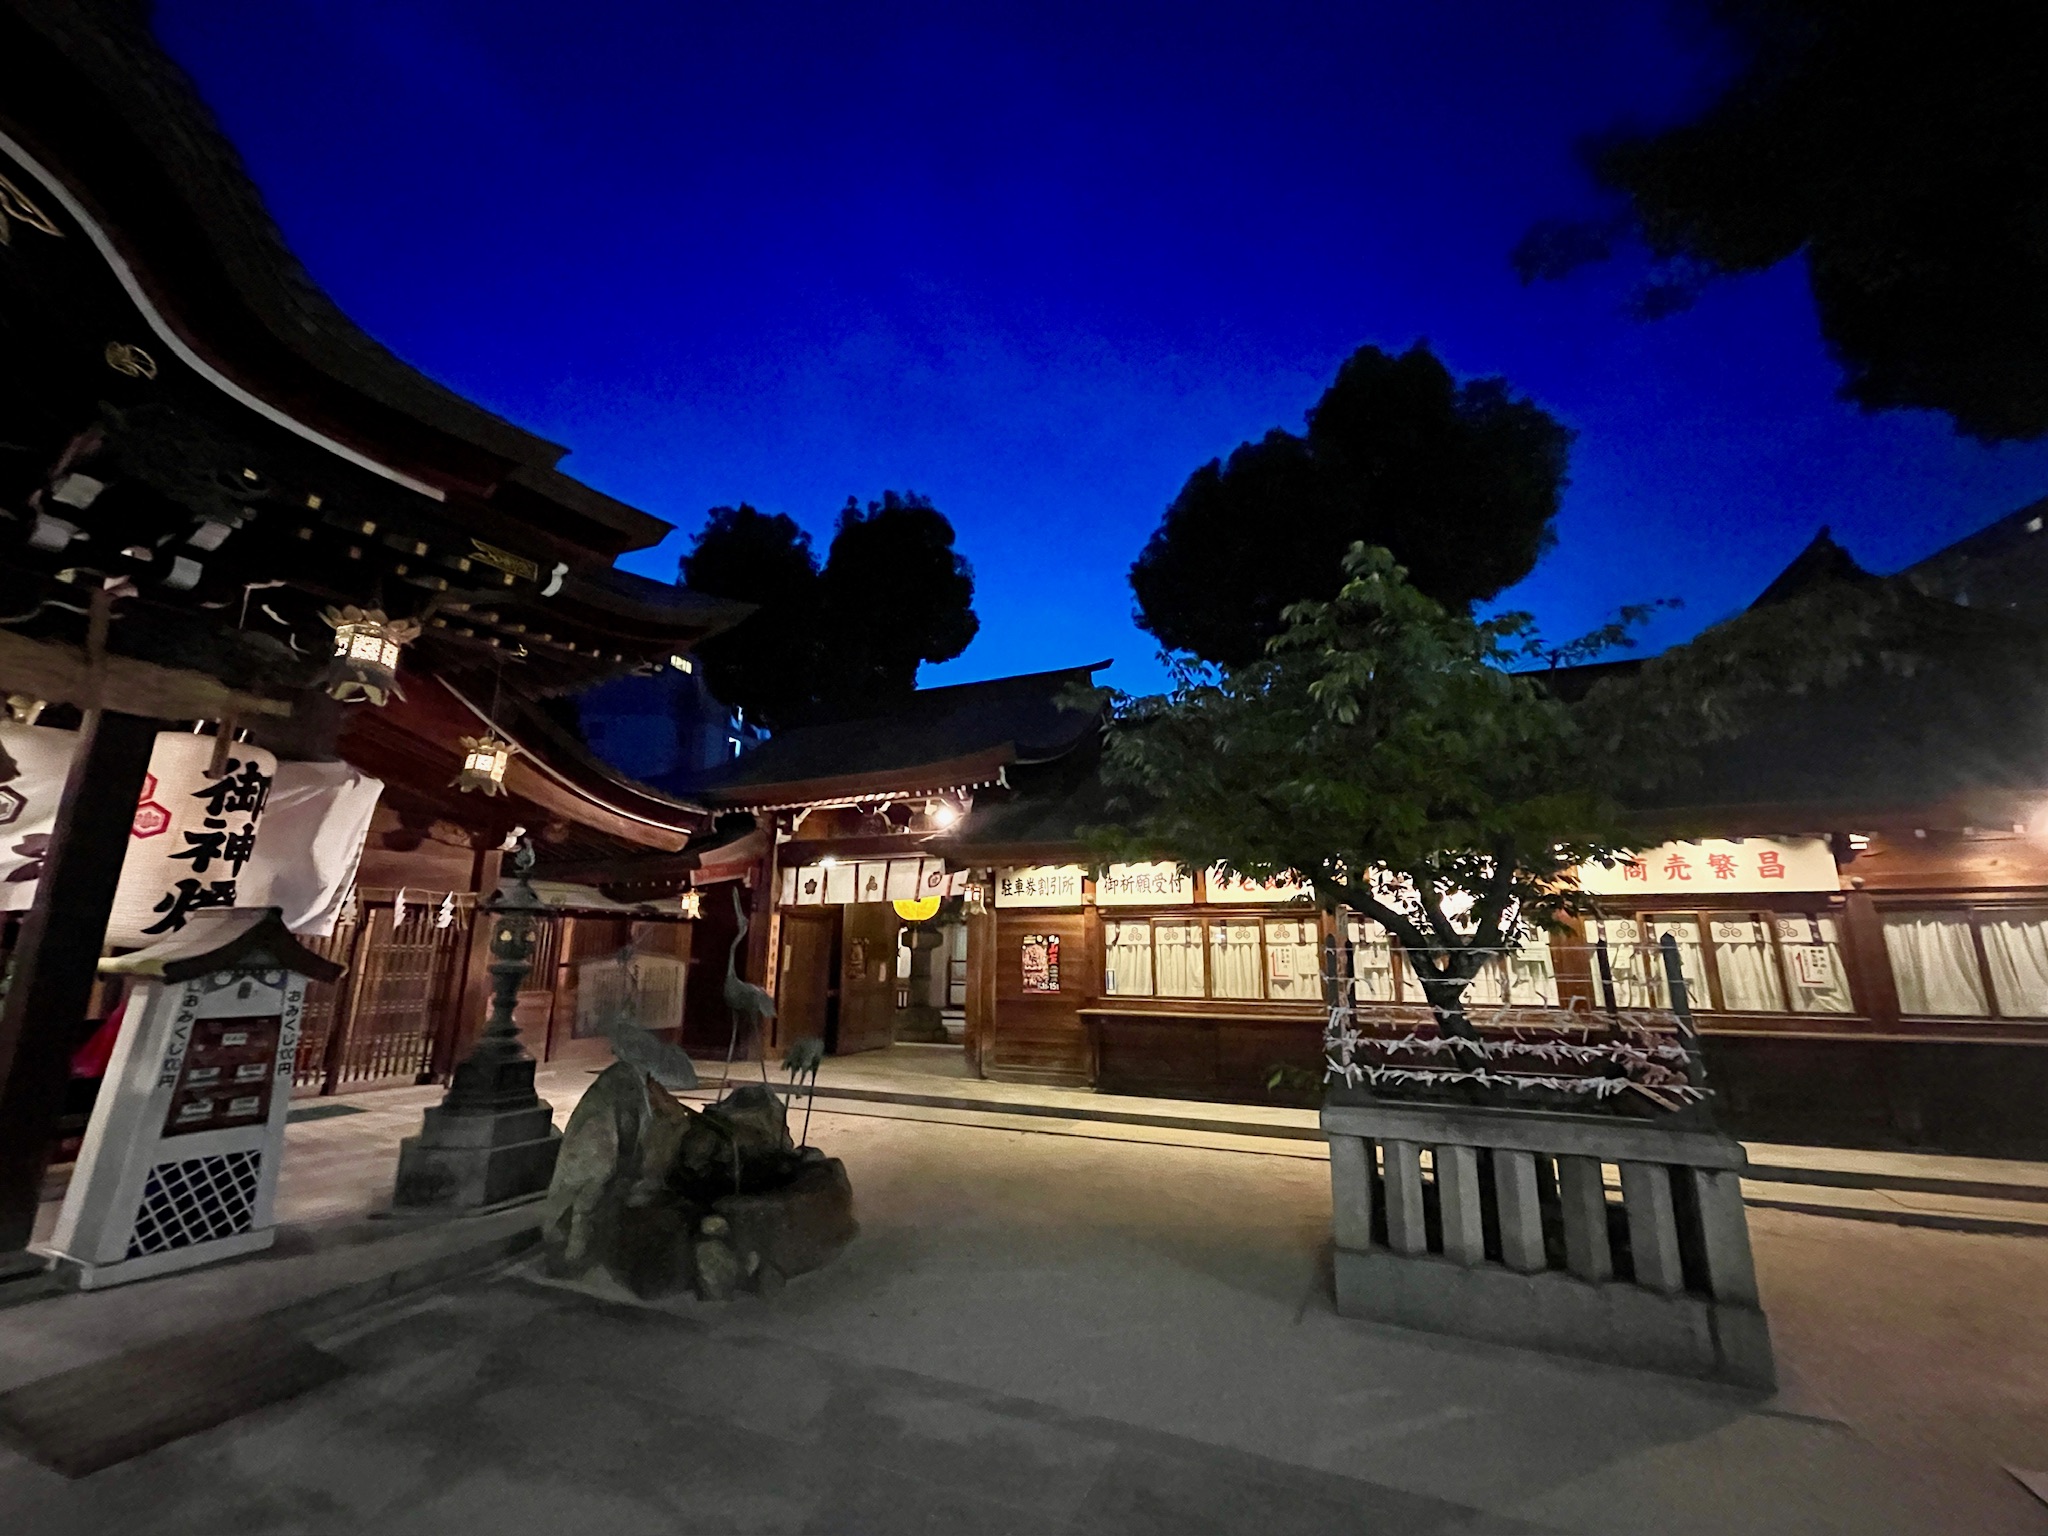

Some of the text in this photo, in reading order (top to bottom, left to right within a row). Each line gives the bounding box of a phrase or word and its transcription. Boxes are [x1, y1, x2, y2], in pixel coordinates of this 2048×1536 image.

[1623, 850, 1786, 882] 商売繁昌
[1104, 872, 1185, 895] 御祈願受付
